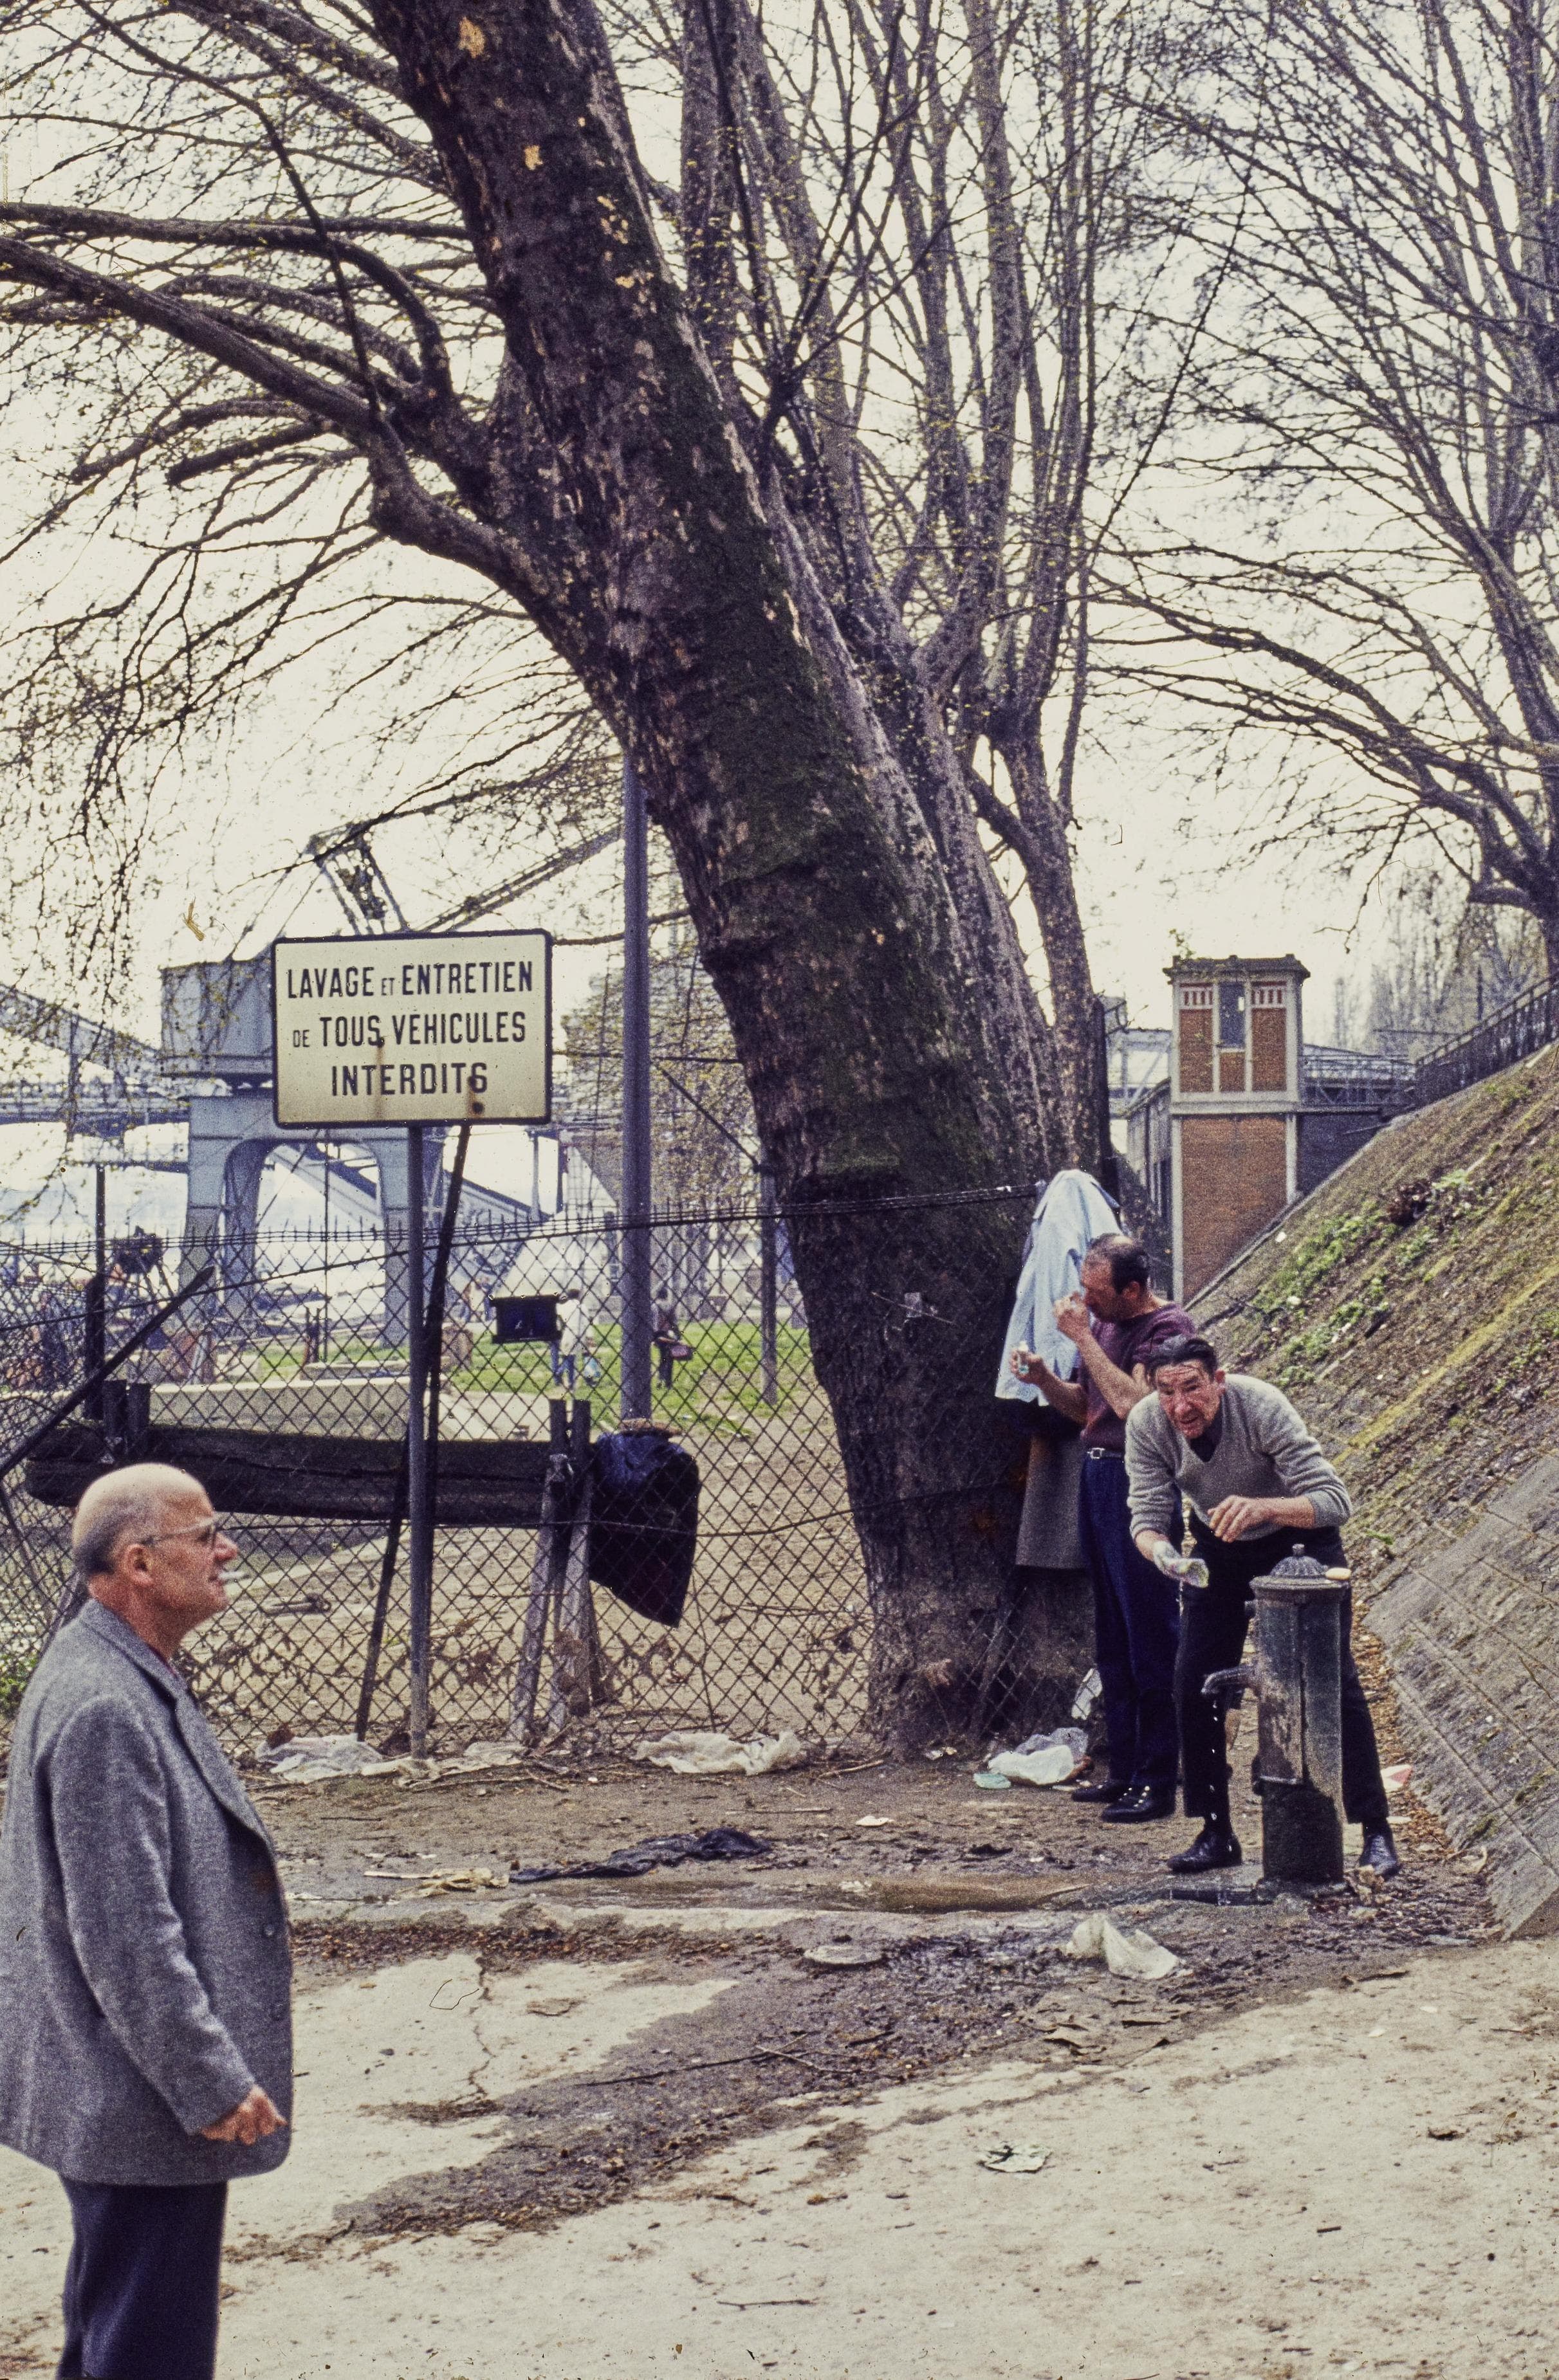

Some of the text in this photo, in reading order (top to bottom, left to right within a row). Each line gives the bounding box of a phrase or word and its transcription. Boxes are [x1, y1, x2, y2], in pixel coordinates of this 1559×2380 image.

[288, 961, 533, 998] LAVAGE ET ENTRETIEN
[293, 1030, 309, 1047] DE
[320, 1015, 381, 1047] TOUS
[332, 1062, 487, 1095] INTERDITS
